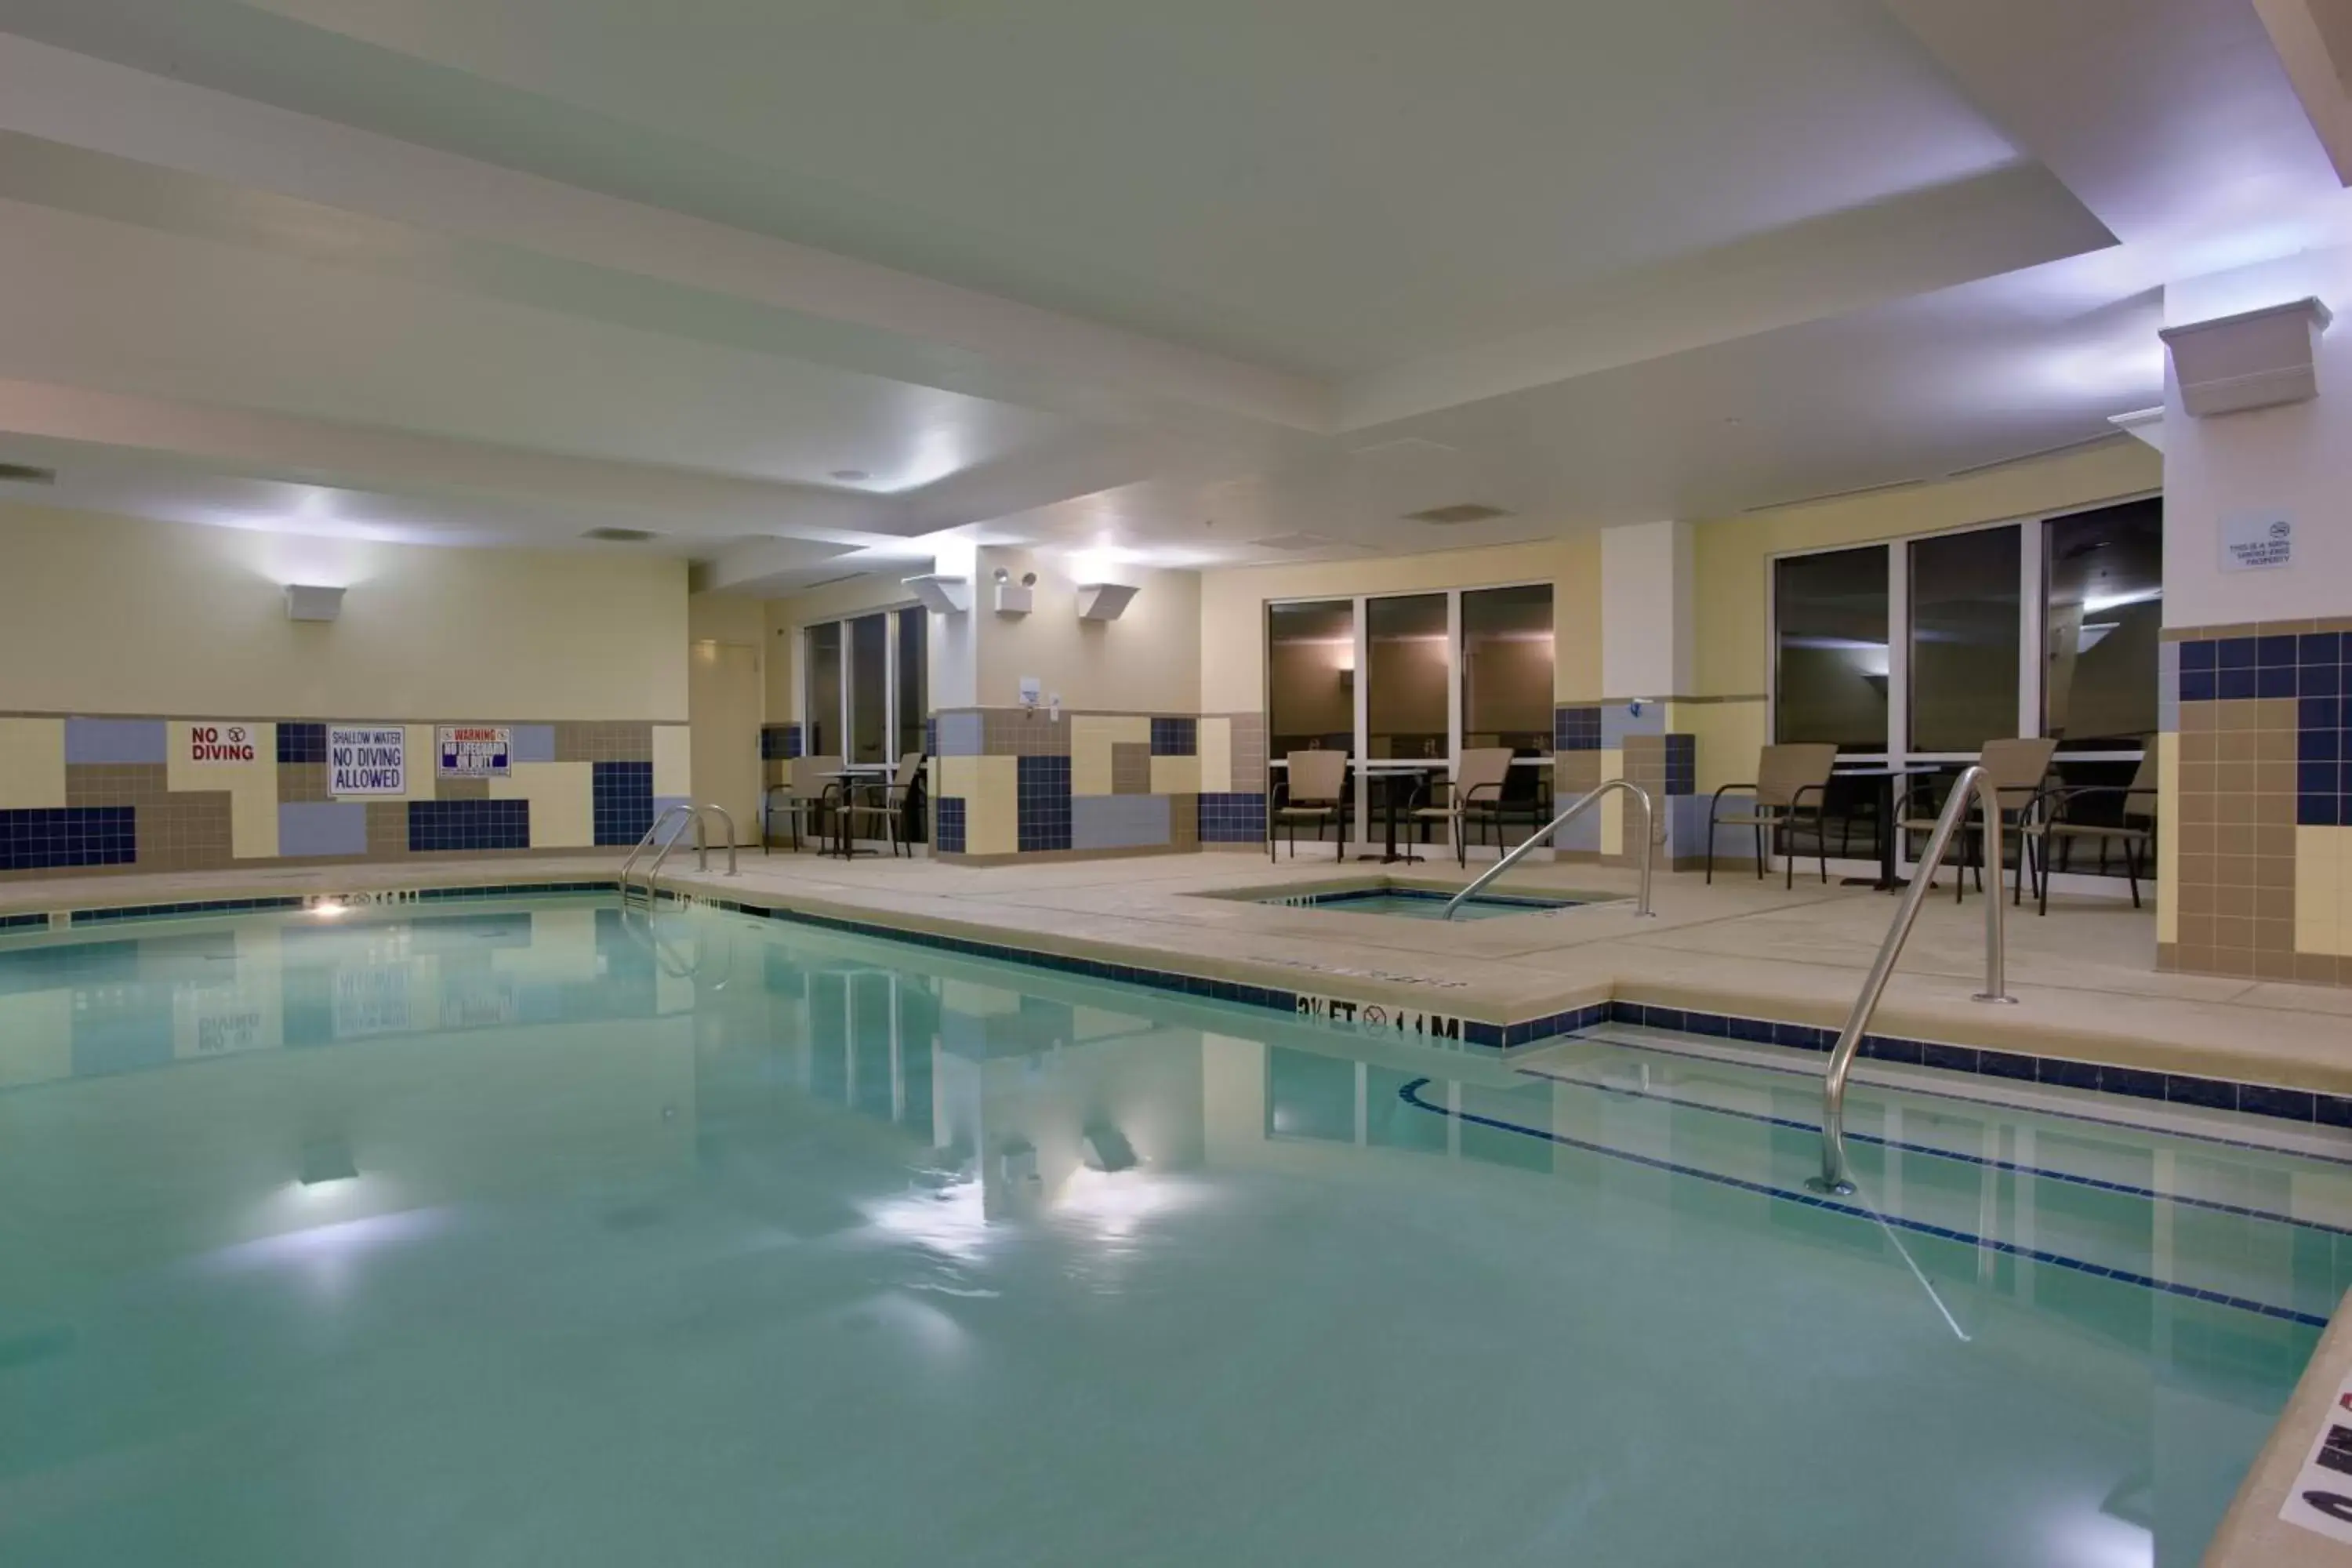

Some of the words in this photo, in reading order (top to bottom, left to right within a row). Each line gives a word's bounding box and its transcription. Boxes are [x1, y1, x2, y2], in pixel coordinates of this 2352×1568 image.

[192, 728, 218, 743] NO
[332, 731, 371, 744] SHALLOW
[373, 731, 401, 744] WATER
[455, 728, 496, 741] WARNING
[192, 745, 254, 761] DIVING
[333, 747, 352, 766] NO
[358, 747, 401, 767] DIVING
[336, 769, 399, 788] ALLOWED
